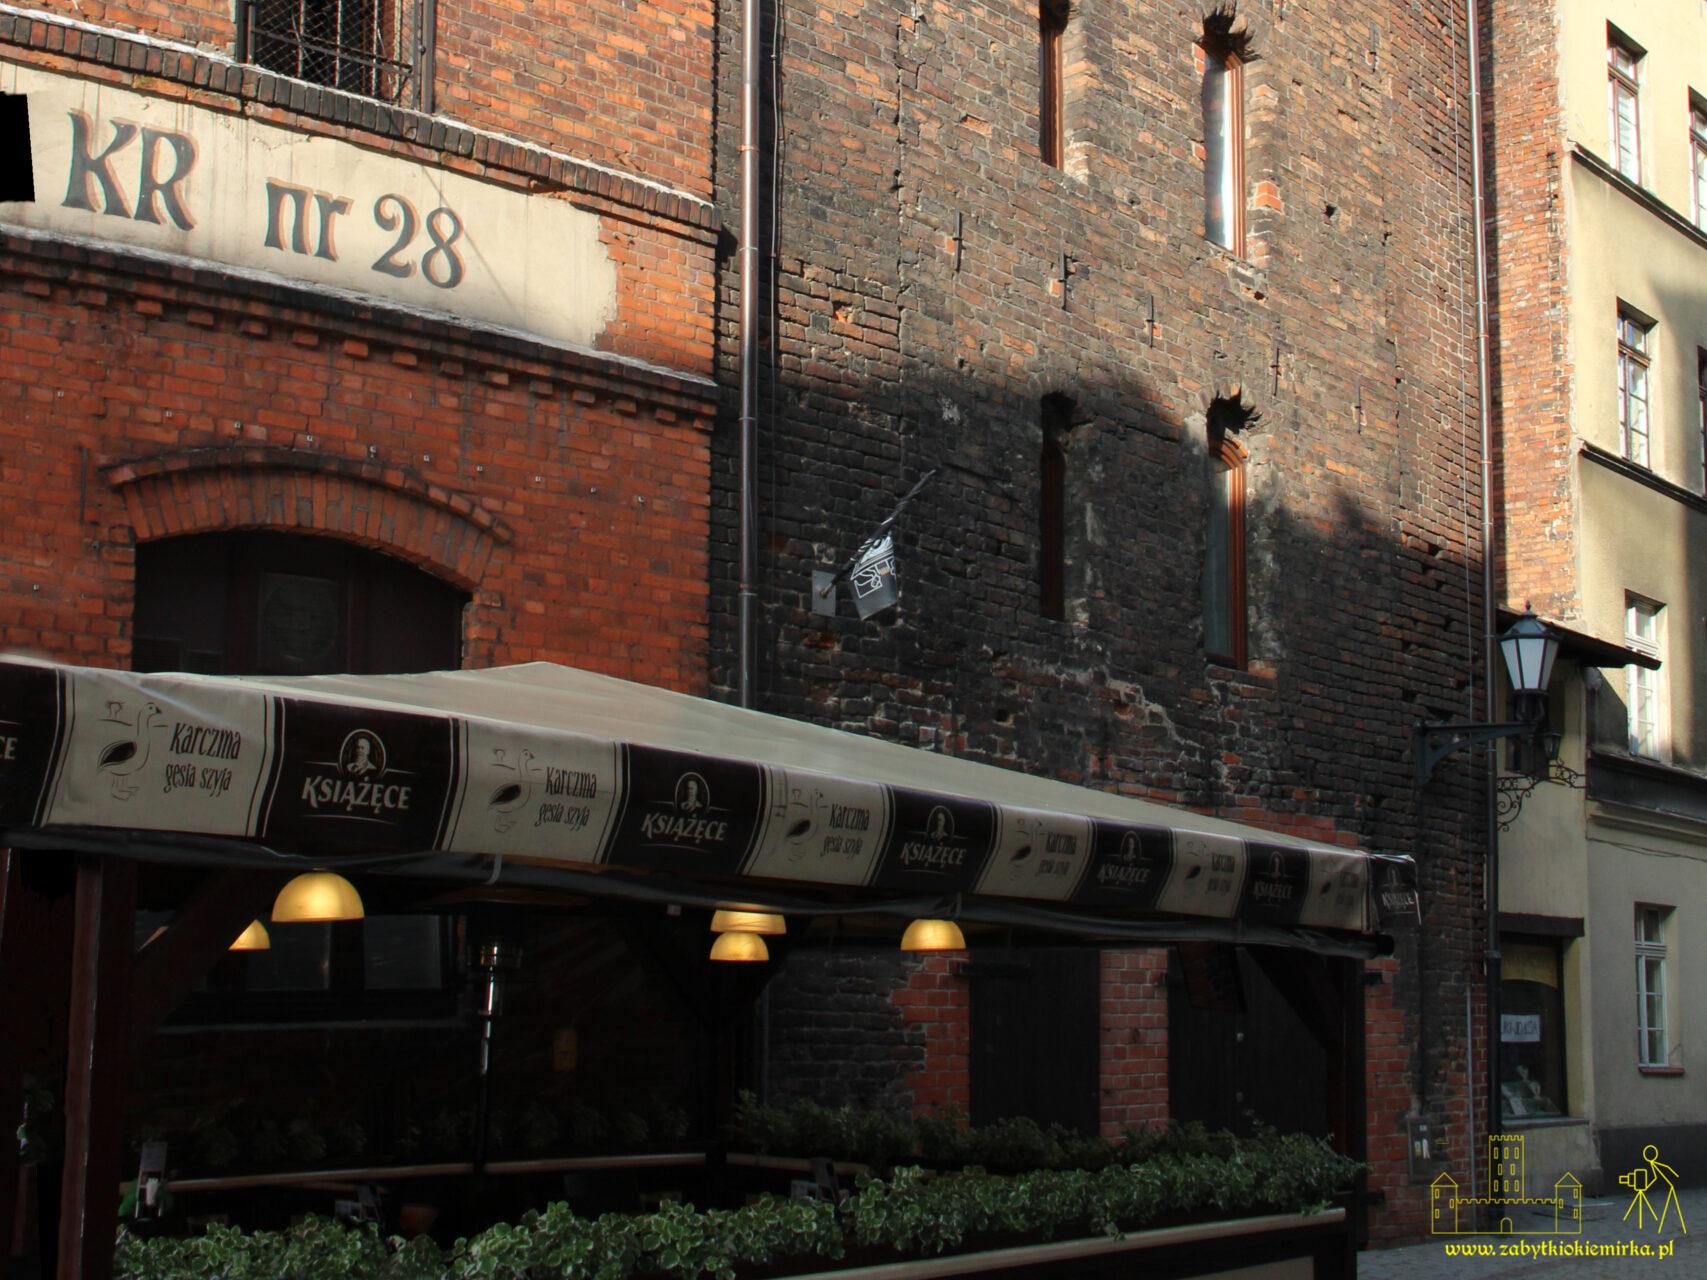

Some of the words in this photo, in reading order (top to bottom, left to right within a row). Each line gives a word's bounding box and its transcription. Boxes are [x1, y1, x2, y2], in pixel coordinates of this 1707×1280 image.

[62, 108, 198, 231] KR
[264, 176, 353, 262] nr
[372, 192, 466, 289] 28
[169, 722, 241, 760] Karczma
[200, 767, 232, 798] szyja
[301, 775, 412, 815] KSIĄŻĘCE
[545, 766, 597, 799] Karczma
[641, 812, 729, 844] KSIĄŻĘCE
